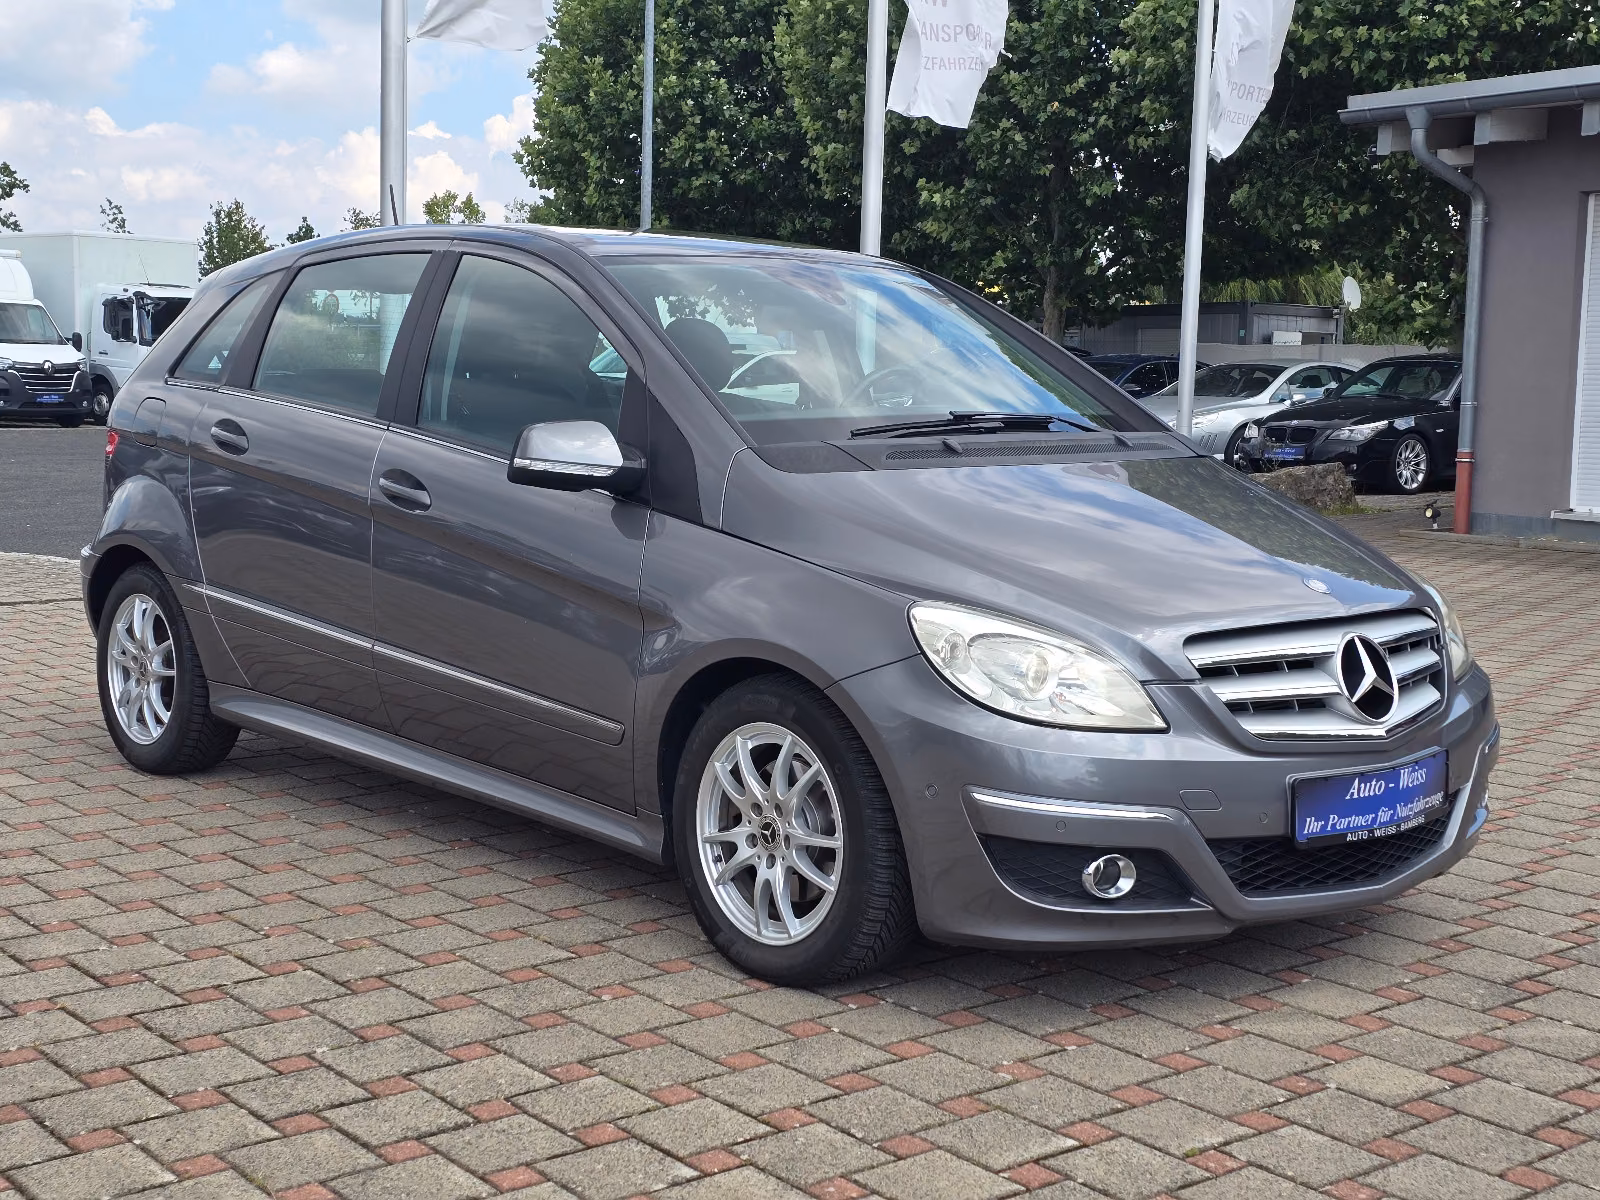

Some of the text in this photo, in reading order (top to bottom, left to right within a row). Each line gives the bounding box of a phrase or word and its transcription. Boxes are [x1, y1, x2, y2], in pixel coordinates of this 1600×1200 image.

[1345, 777, 1386, 800] Auto
[1400, 766, 1427, 790] Weiss
[1303, 791, 1444, 834] Ihr Partner für Nutzfahrzeuge
[1346, 830, 1368, 842] AUTO
[1374, 825, 1397, 838] WEISS
[1400, 814, 1425, 831] BAMBERG
